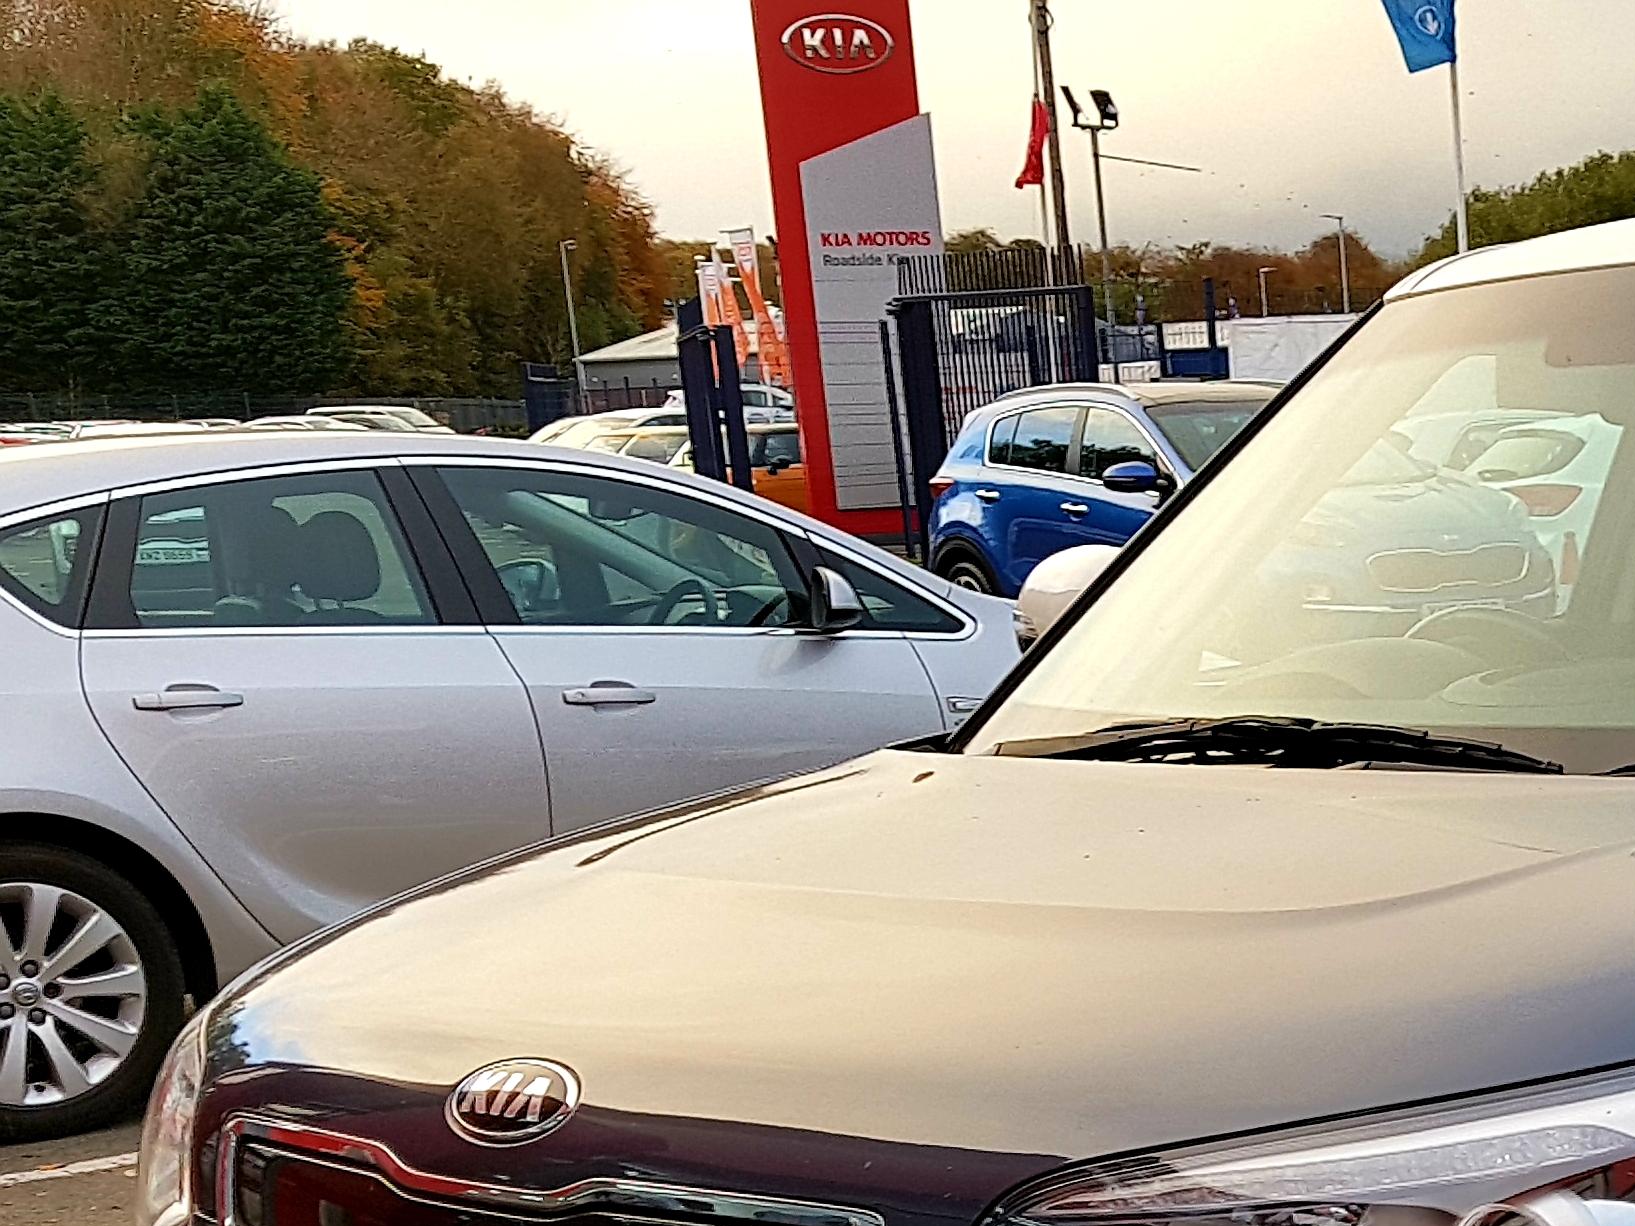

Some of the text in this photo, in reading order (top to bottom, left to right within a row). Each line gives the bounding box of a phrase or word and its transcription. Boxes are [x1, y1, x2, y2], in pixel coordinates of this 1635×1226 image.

[801, 27, 876, 59] KIA
[820, 230, 931, 247] KIA MOTORS
[822, 252, 883, 267] Roadside
[459, 1070, 552, 1123] KIA
